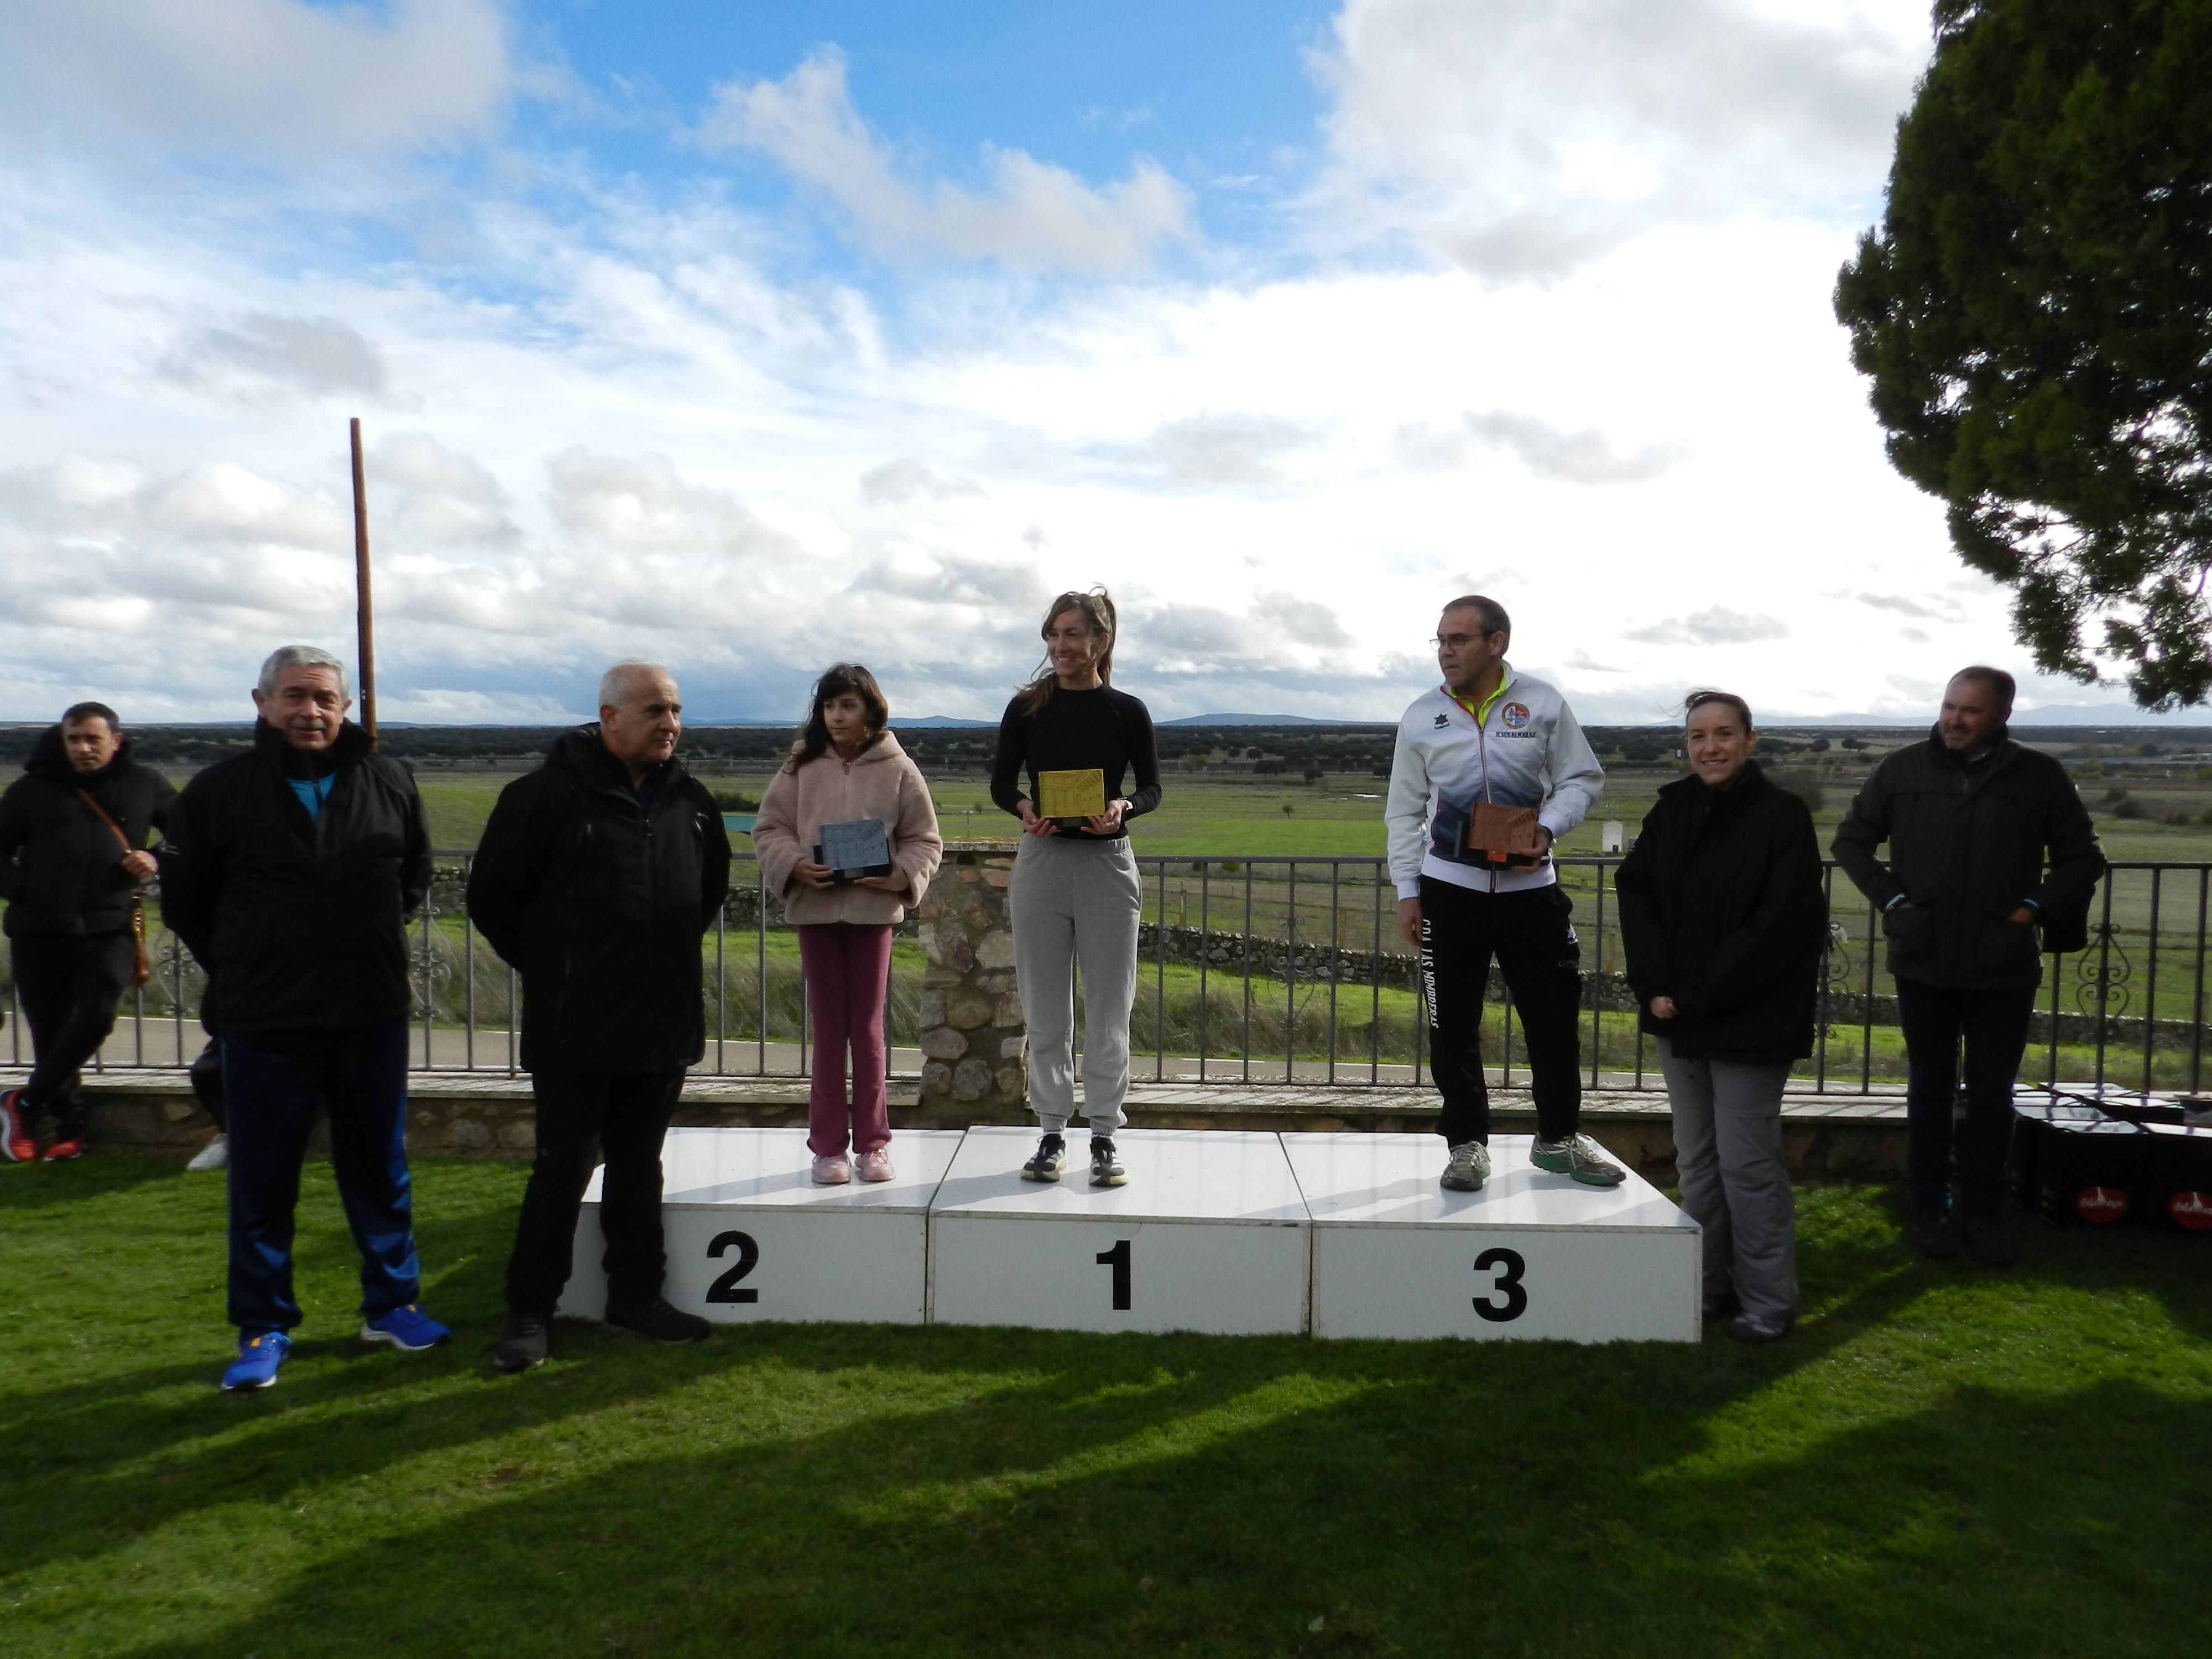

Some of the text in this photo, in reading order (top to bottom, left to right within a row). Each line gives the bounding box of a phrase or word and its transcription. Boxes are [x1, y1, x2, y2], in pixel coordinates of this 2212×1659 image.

[1422, 969, 1439, 1029] MIMBRERAS
[706, 1229, 759, 1304] 2
[1096, 1240, 1131, 1311] 1
[1472, 1248, 1527, 1322] 3
